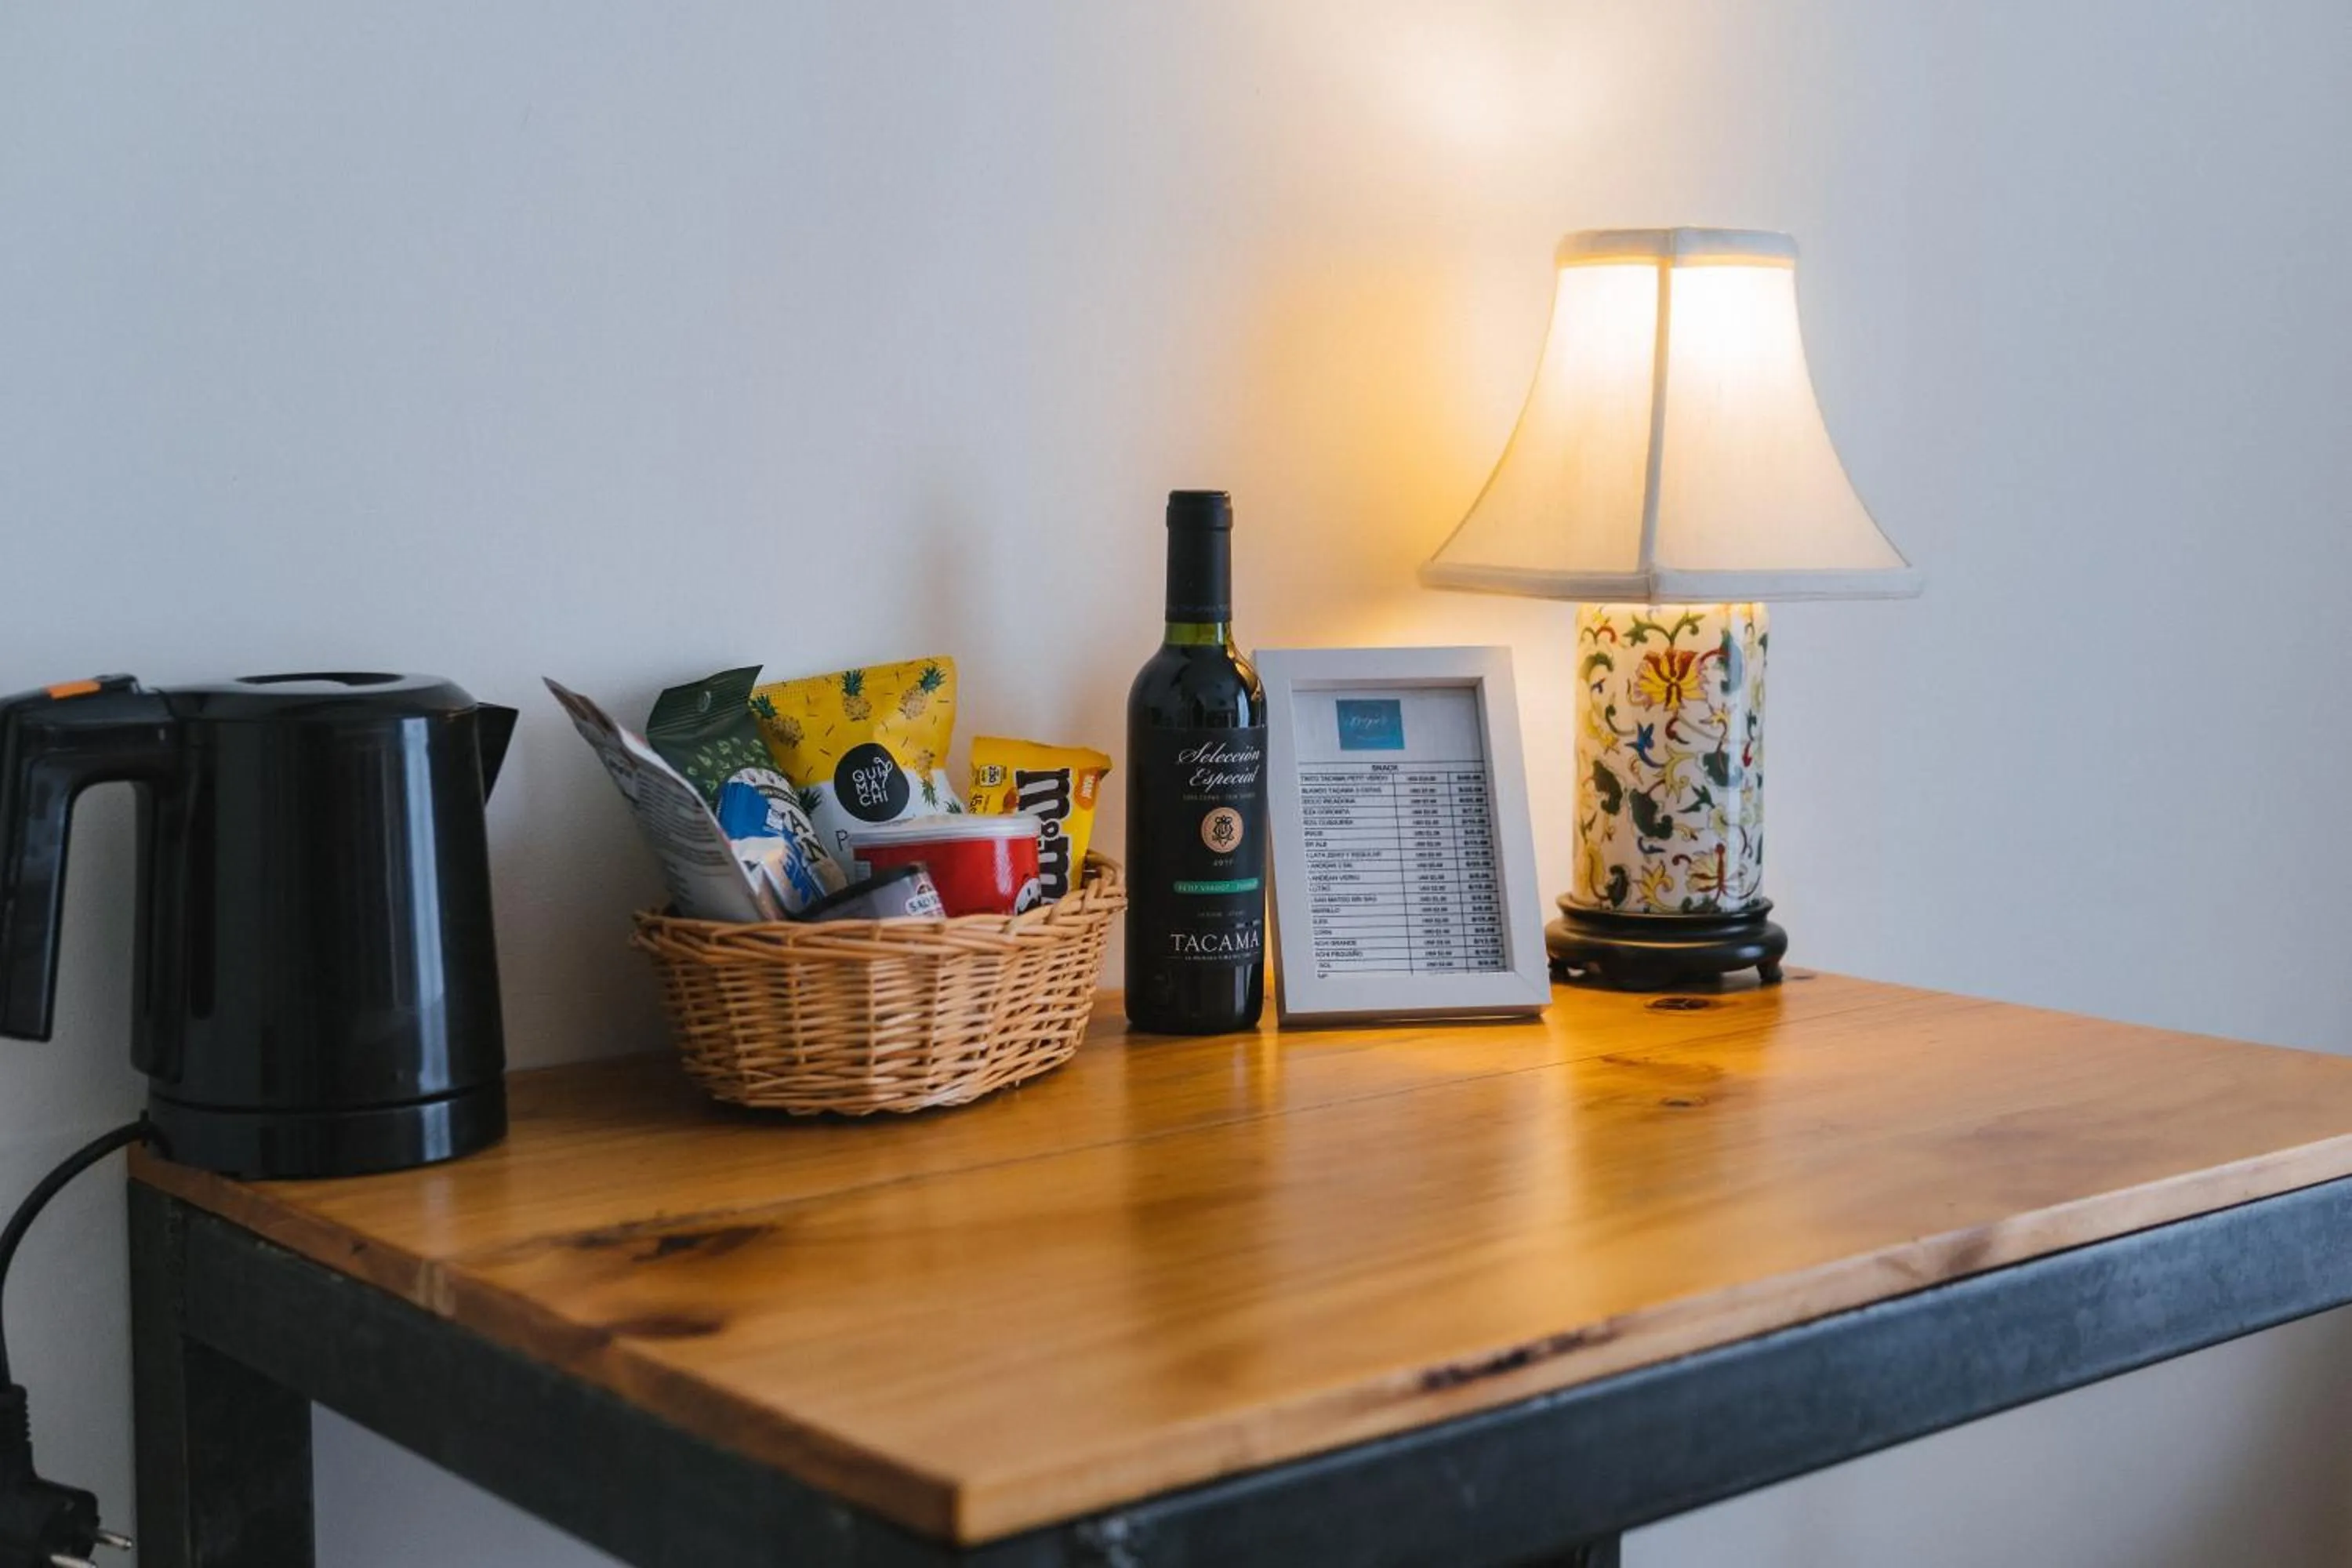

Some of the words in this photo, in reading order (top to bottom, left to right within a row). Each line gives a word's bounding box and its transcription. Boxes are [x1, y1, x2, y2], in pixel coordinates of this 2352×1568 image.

[1178, 741, 1260, 764] Selección
[1189, 764, 1260, 793] Especial
[1171, 929, 1260, 953] TACAMA
